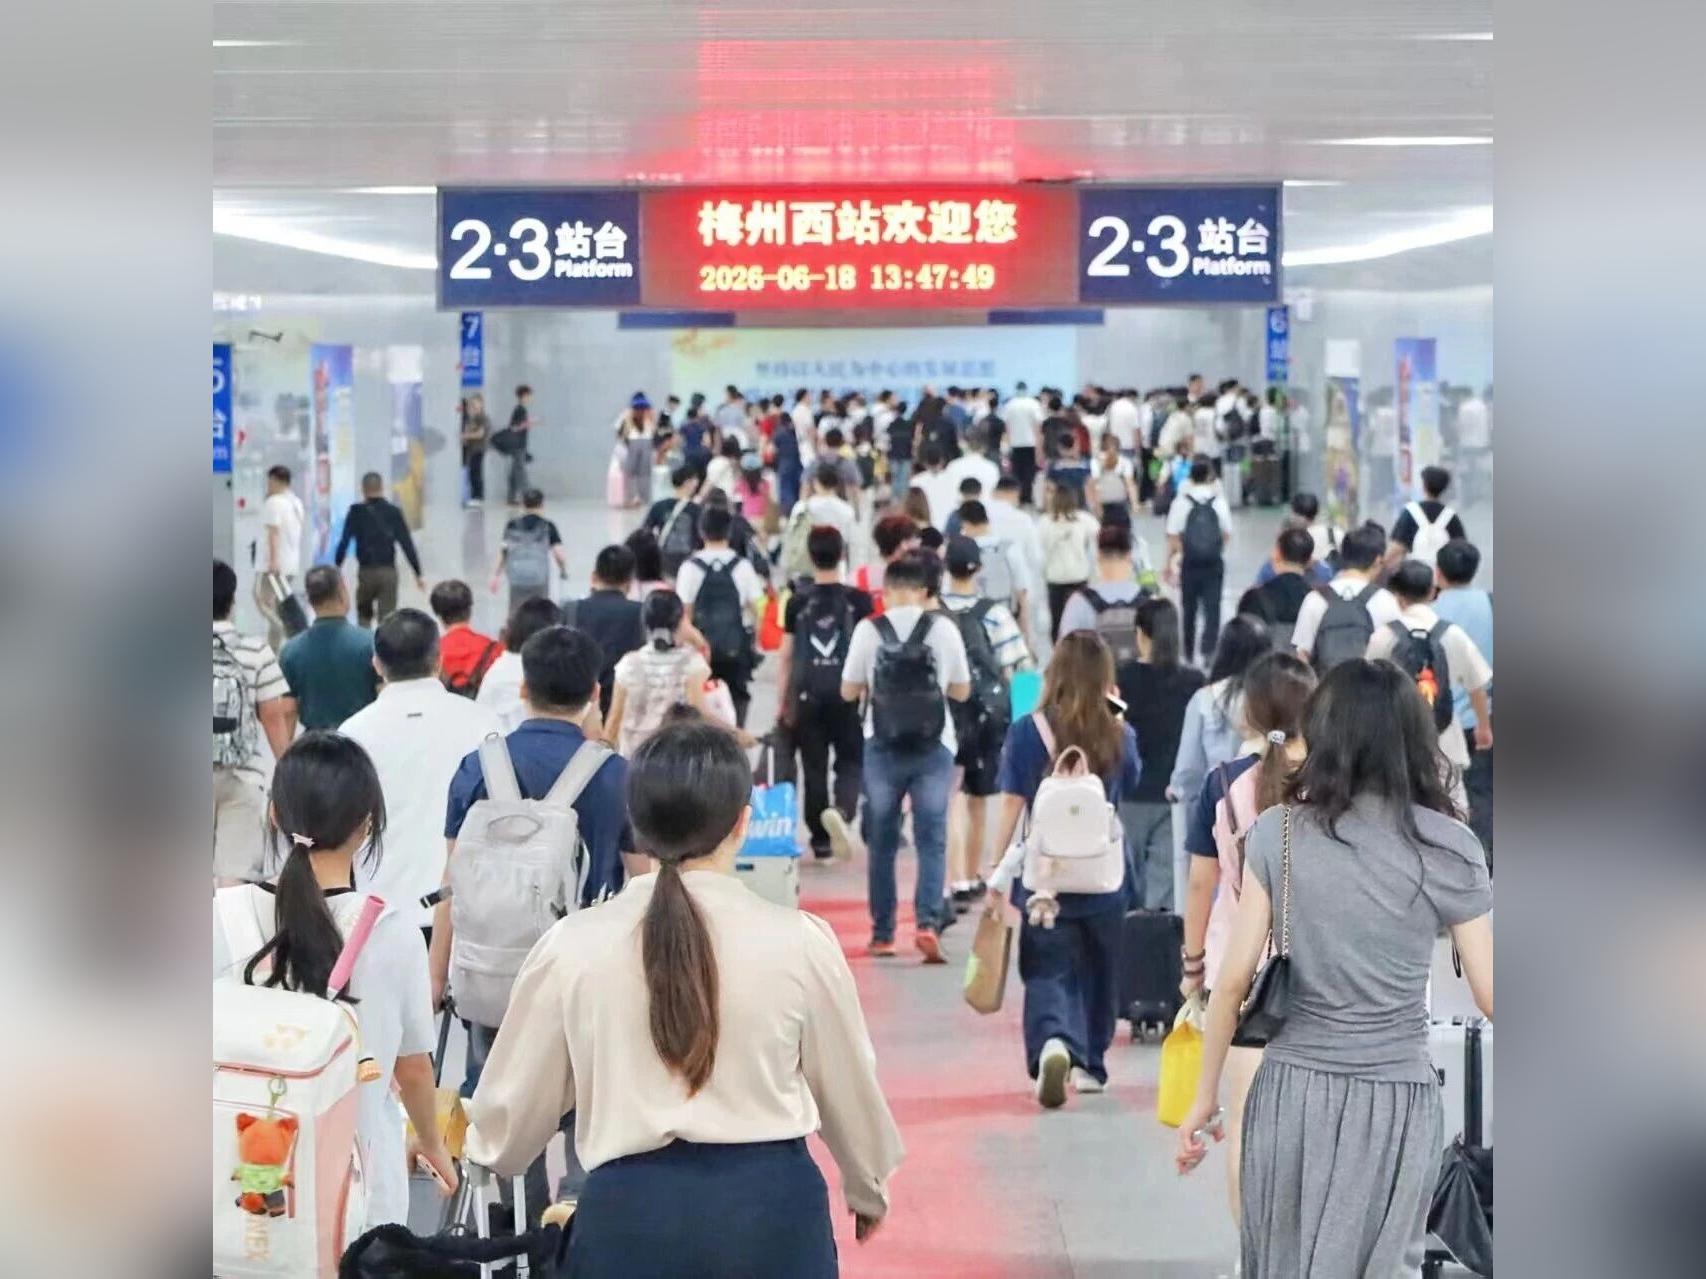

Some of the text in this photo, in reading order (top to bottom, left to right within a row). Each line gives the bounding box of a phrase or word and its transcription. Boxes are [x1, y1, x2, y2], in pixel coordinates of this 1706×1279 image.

[697, 199, 1018, 246] 梅州西站欢迎您
[1197, 216, 1270, 256] 站台
[555, 220, 628, 259] 站台
[555, 259, 633, 279] Platform
[699, 263, 996, 291] 2026-06-18 13:47:49
[1192, 255, 1272, 276] Platform
[464, 314, 480, 340] 7
